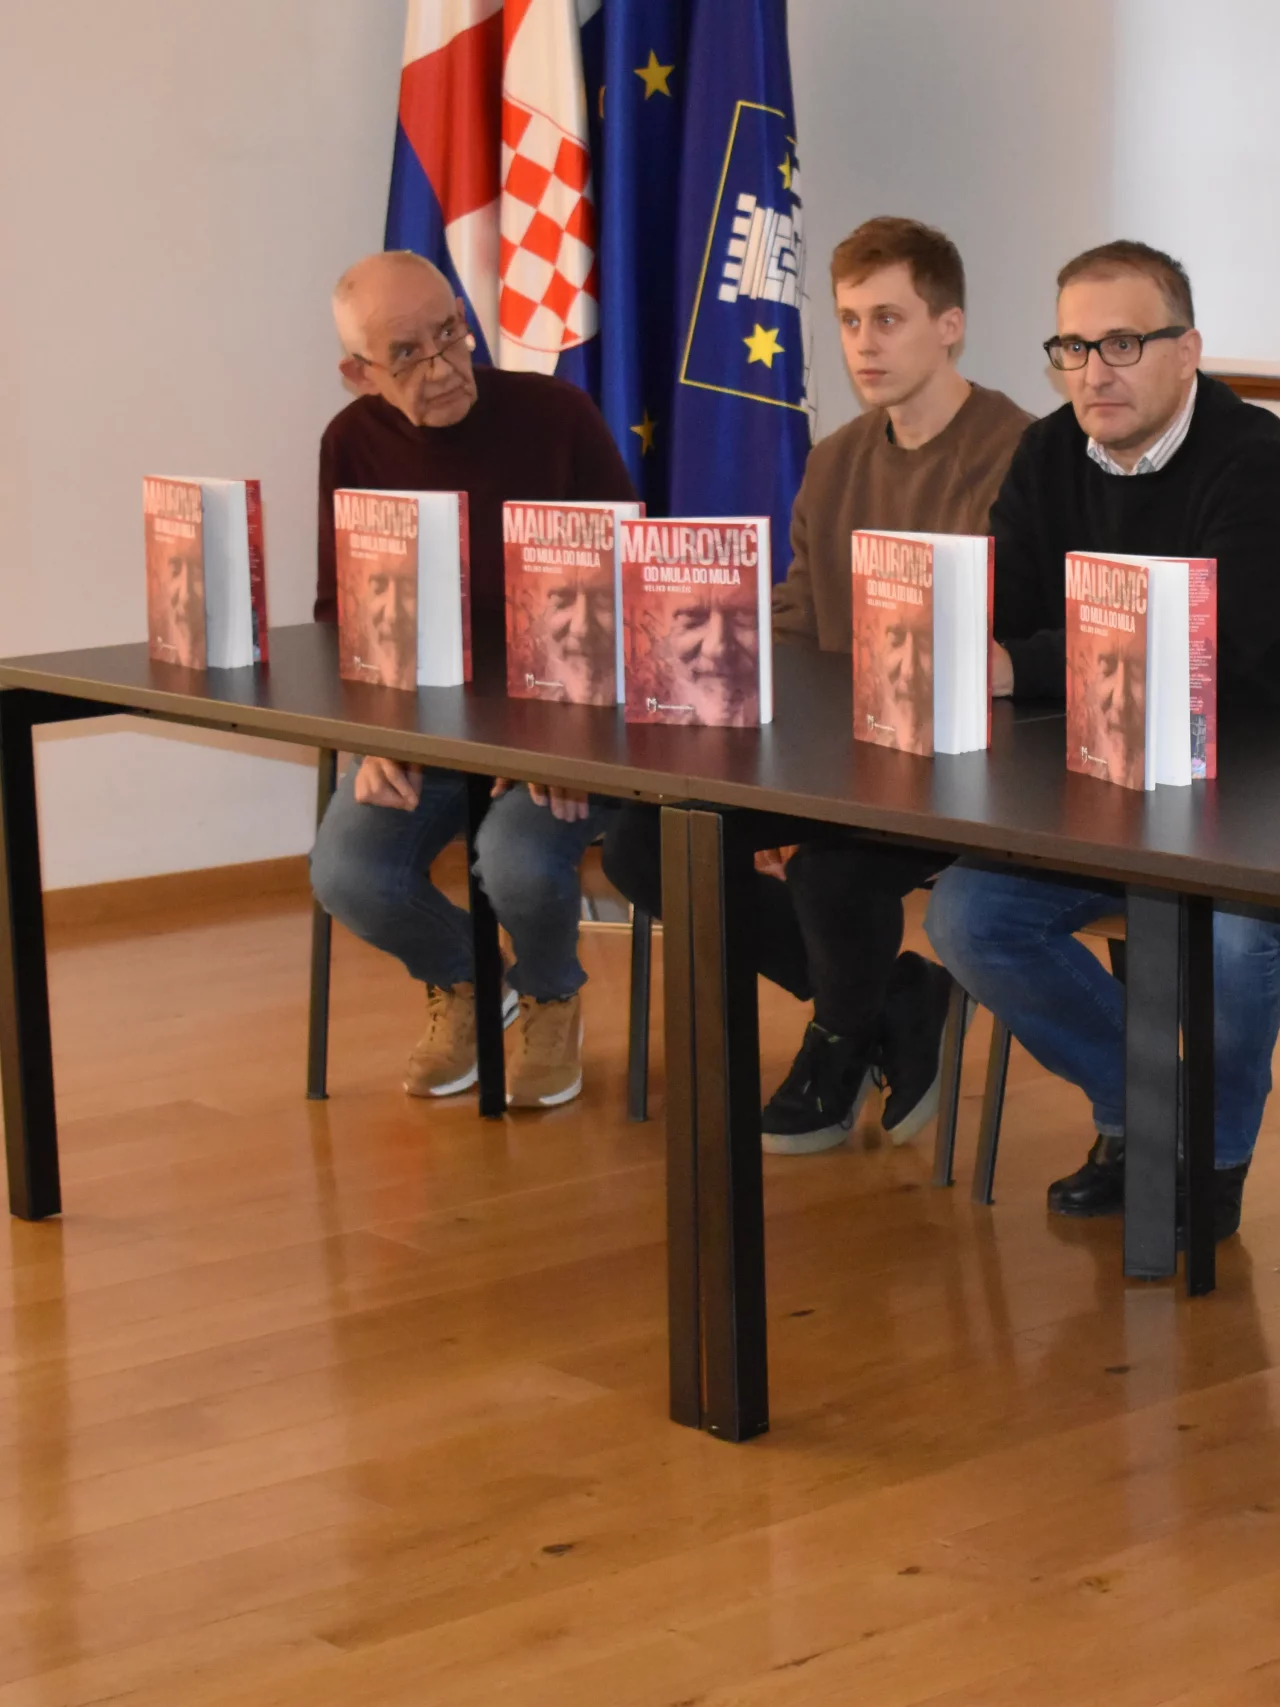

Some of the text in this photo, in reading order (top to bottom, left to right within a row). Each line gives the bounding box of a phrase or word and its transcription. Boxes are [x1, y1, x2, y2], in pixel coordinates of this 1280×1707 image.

[504, 507, 613, 551] MAUROVIĆ
[621, 524, 757, 567] MAUROVIĆ
[644, 566, 740, 585] OD MULA DO MULA
[852, 535, 933, 588] MAUROVIĆ
[1065, 558, 1148, 614] MAUROVIĆ
[1080, 604, 1090, 622] OD
[1090, 607, 1109, 627] MULA
[1109, 610, 1118, 629] DO
[1118, 612, 1136, 633] MULA
